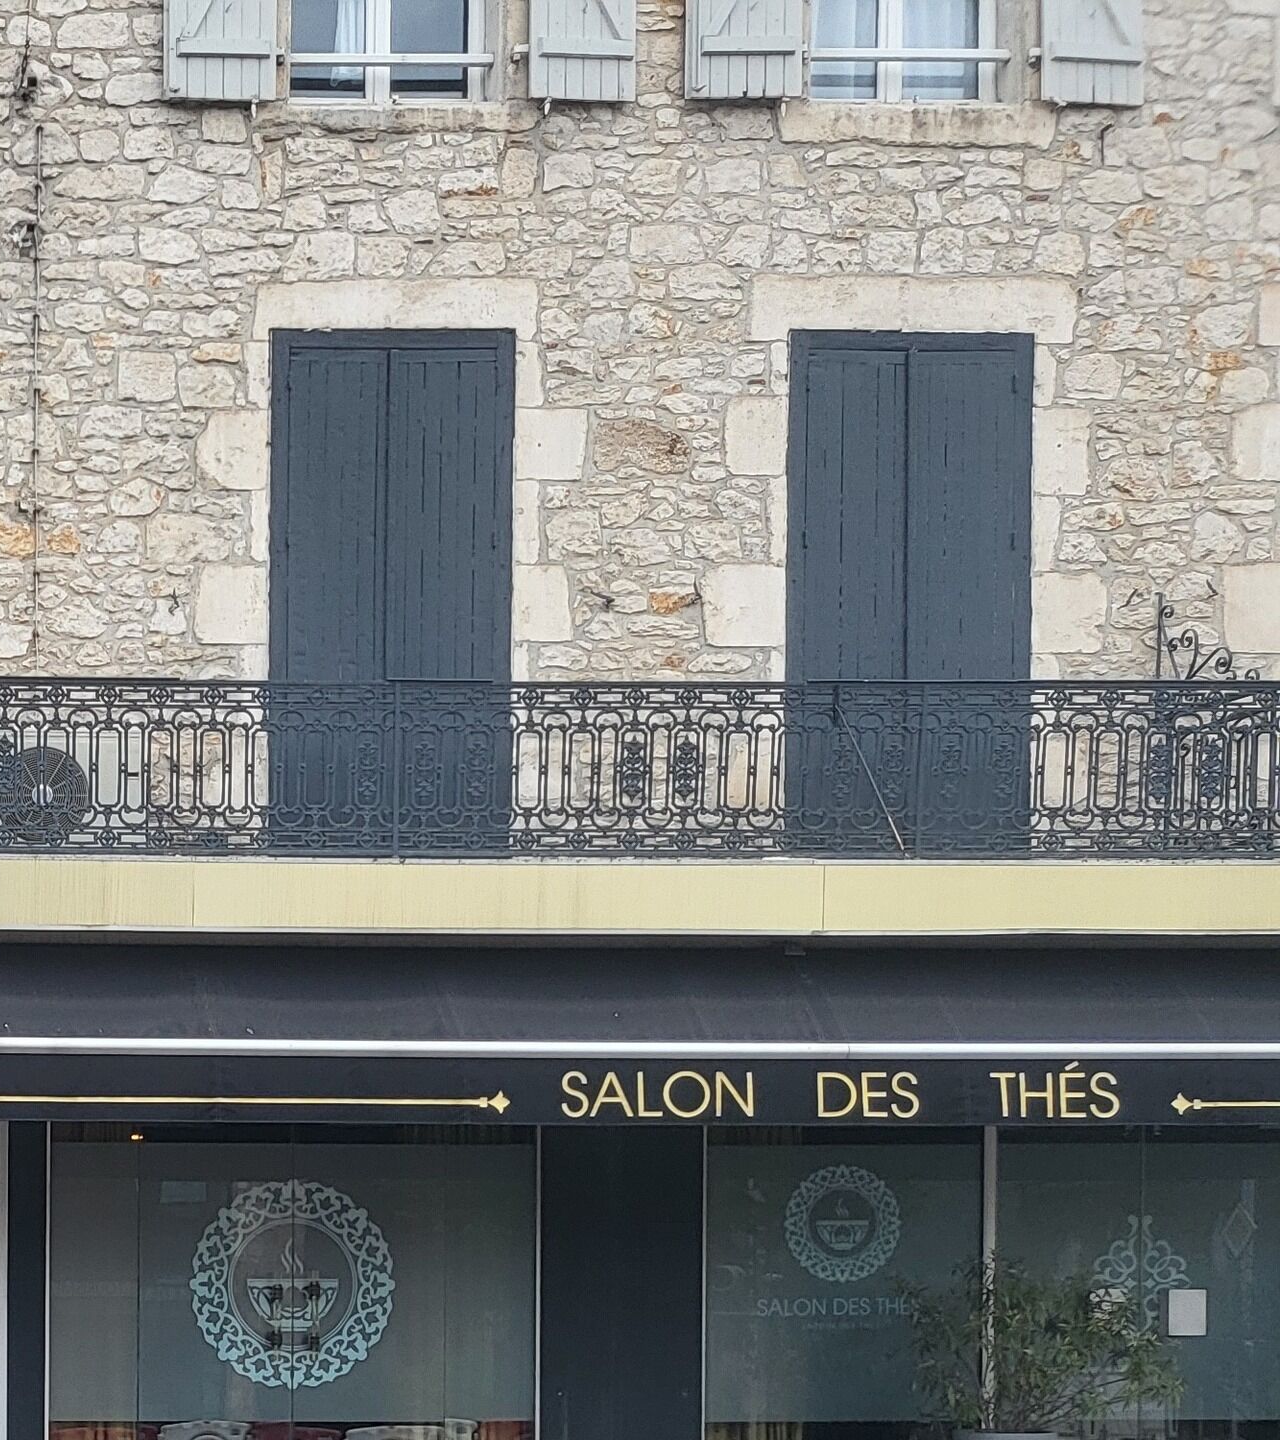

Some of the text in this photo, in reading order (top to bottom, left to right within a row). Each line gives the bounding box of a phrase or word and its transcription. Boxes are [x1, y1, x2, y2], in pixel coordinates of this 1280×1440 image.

[560, 1060, 1121, 1119] SALON DES THÉS
[756, 1298, 827, 1317] SALON
[833, 1297, 871, 1316] DES
